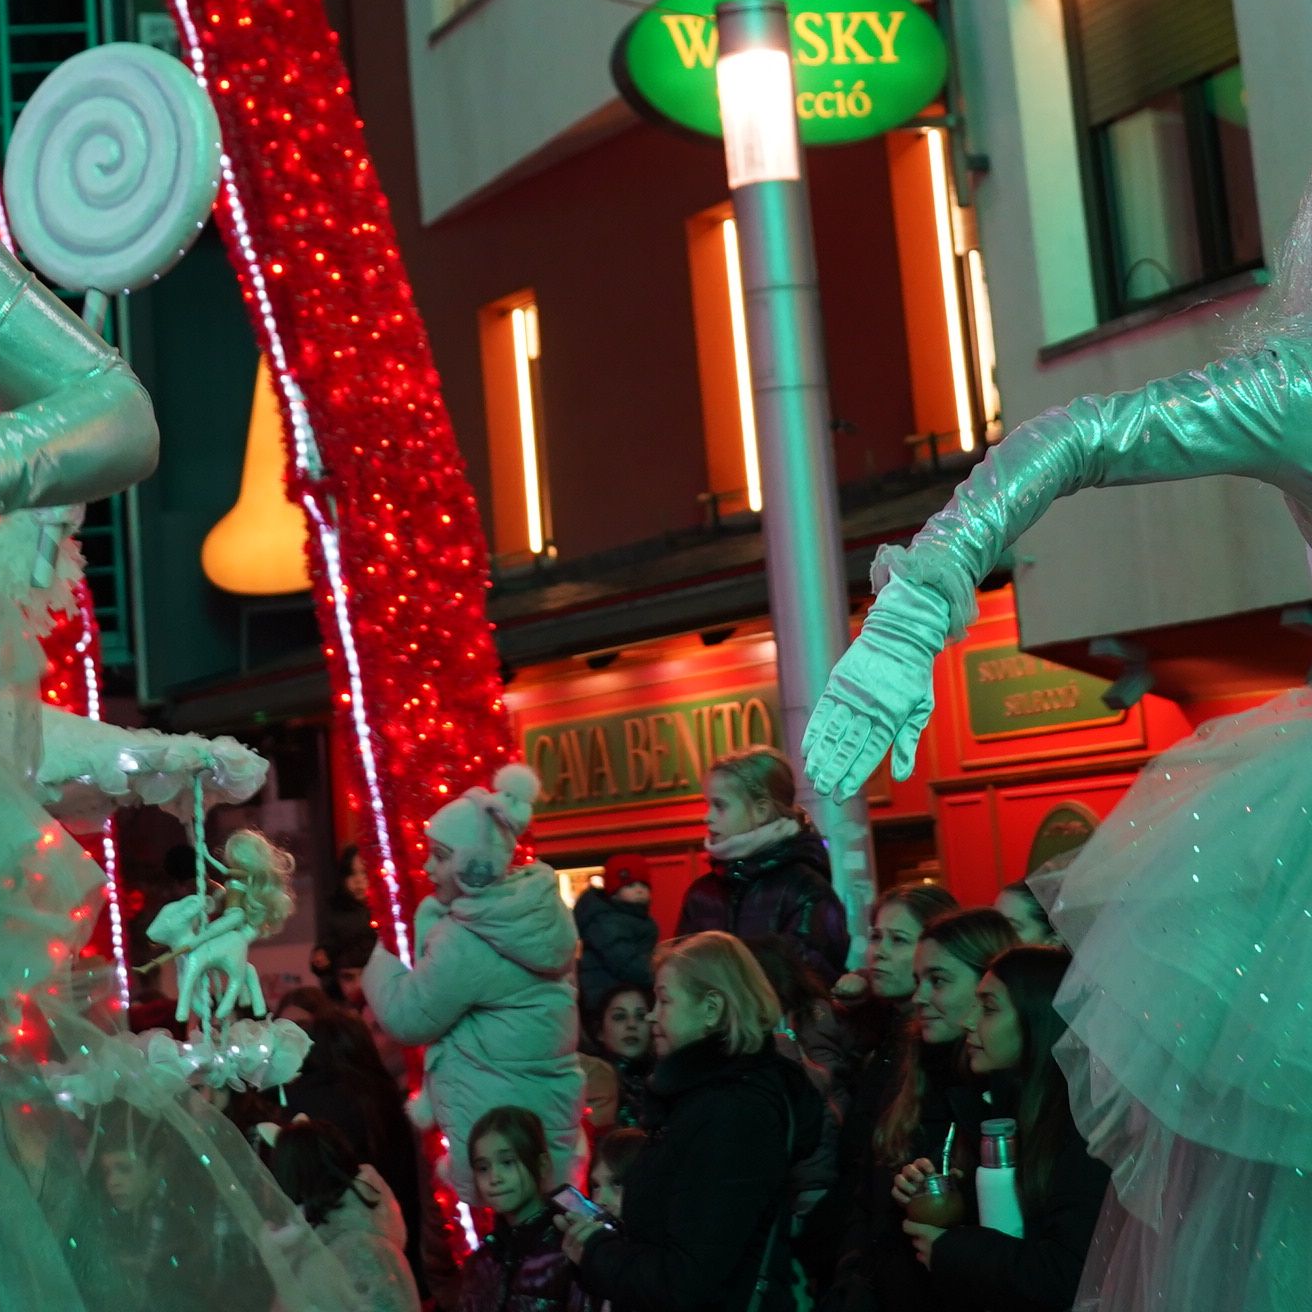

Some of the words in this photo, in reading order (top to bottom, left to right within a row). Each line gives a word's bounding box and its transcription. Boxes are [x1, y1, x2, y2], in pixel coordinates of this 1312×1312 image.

[660, 11, 906, 69] WSKY
[534, 725, 619, 804] CAVA
[623, 697, 773, 793] BENITO
